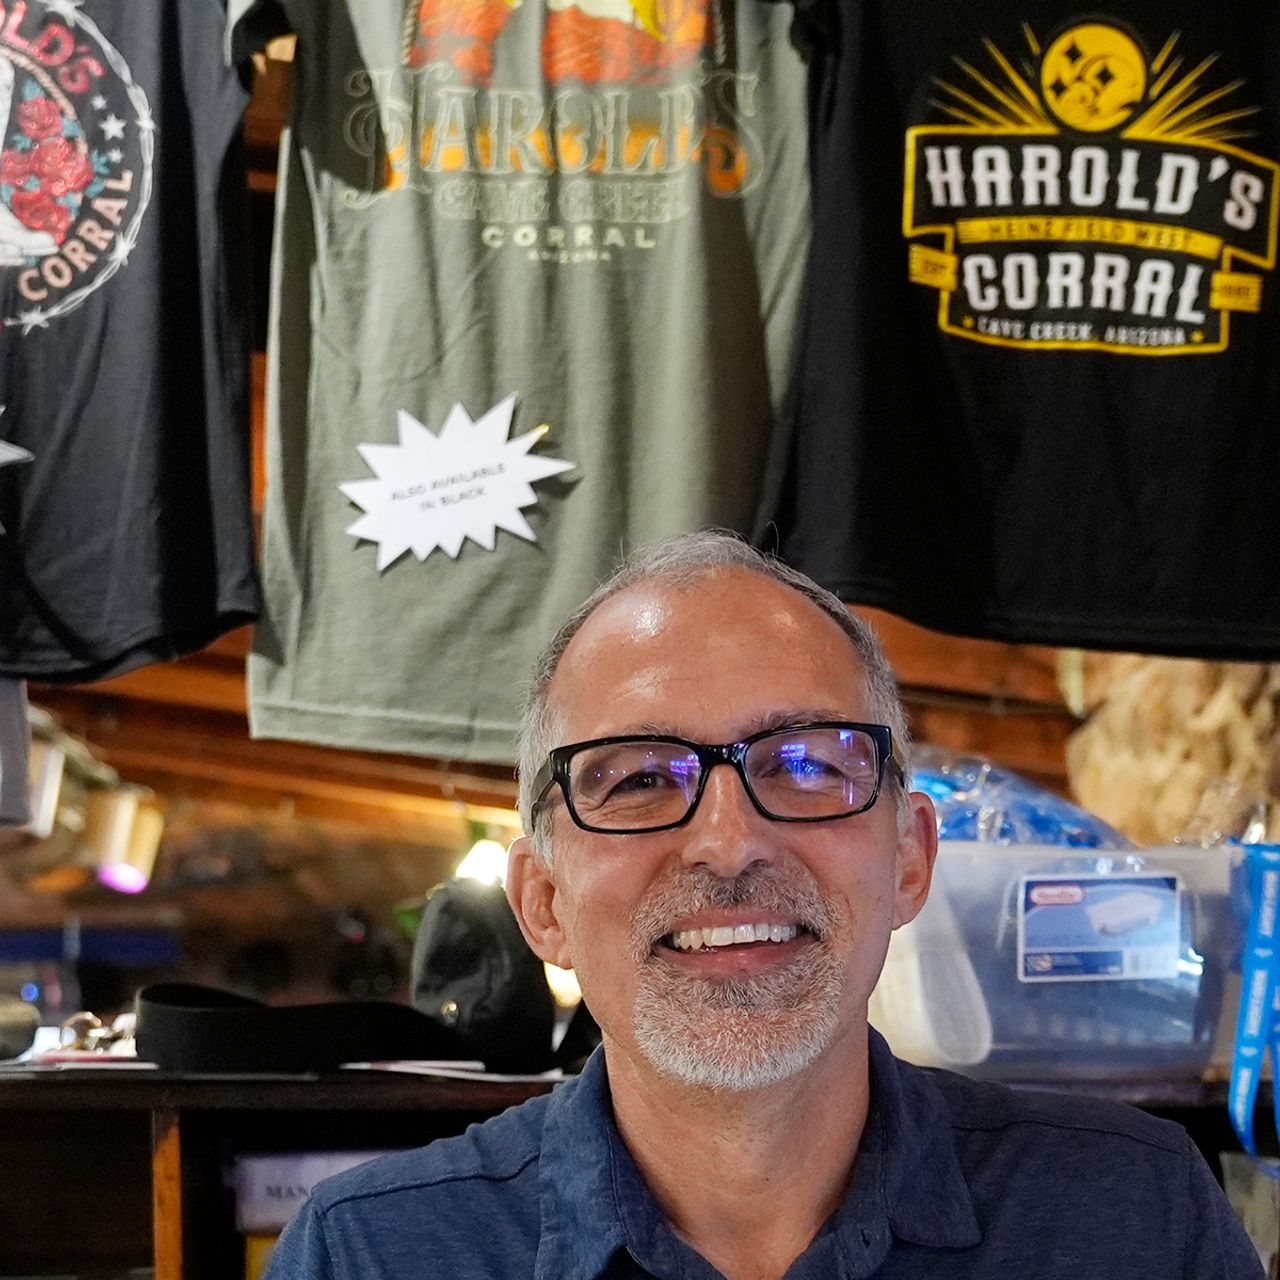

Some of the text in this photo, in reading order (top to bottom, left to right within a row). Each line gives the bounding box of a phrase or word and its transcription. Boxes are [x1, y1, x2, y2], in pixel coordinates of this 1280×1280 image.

[923, 144, 1265, 231] HAROLD'S
[19, 168, 134, 303] CORRAL
[480, 228, 657, 249] CORRAL
[961, 252, 1207, 325] CORRAL
[391, 462, 507, 502] ALSO AVAILABLE
[439, 486, 488, 505] BLACK
